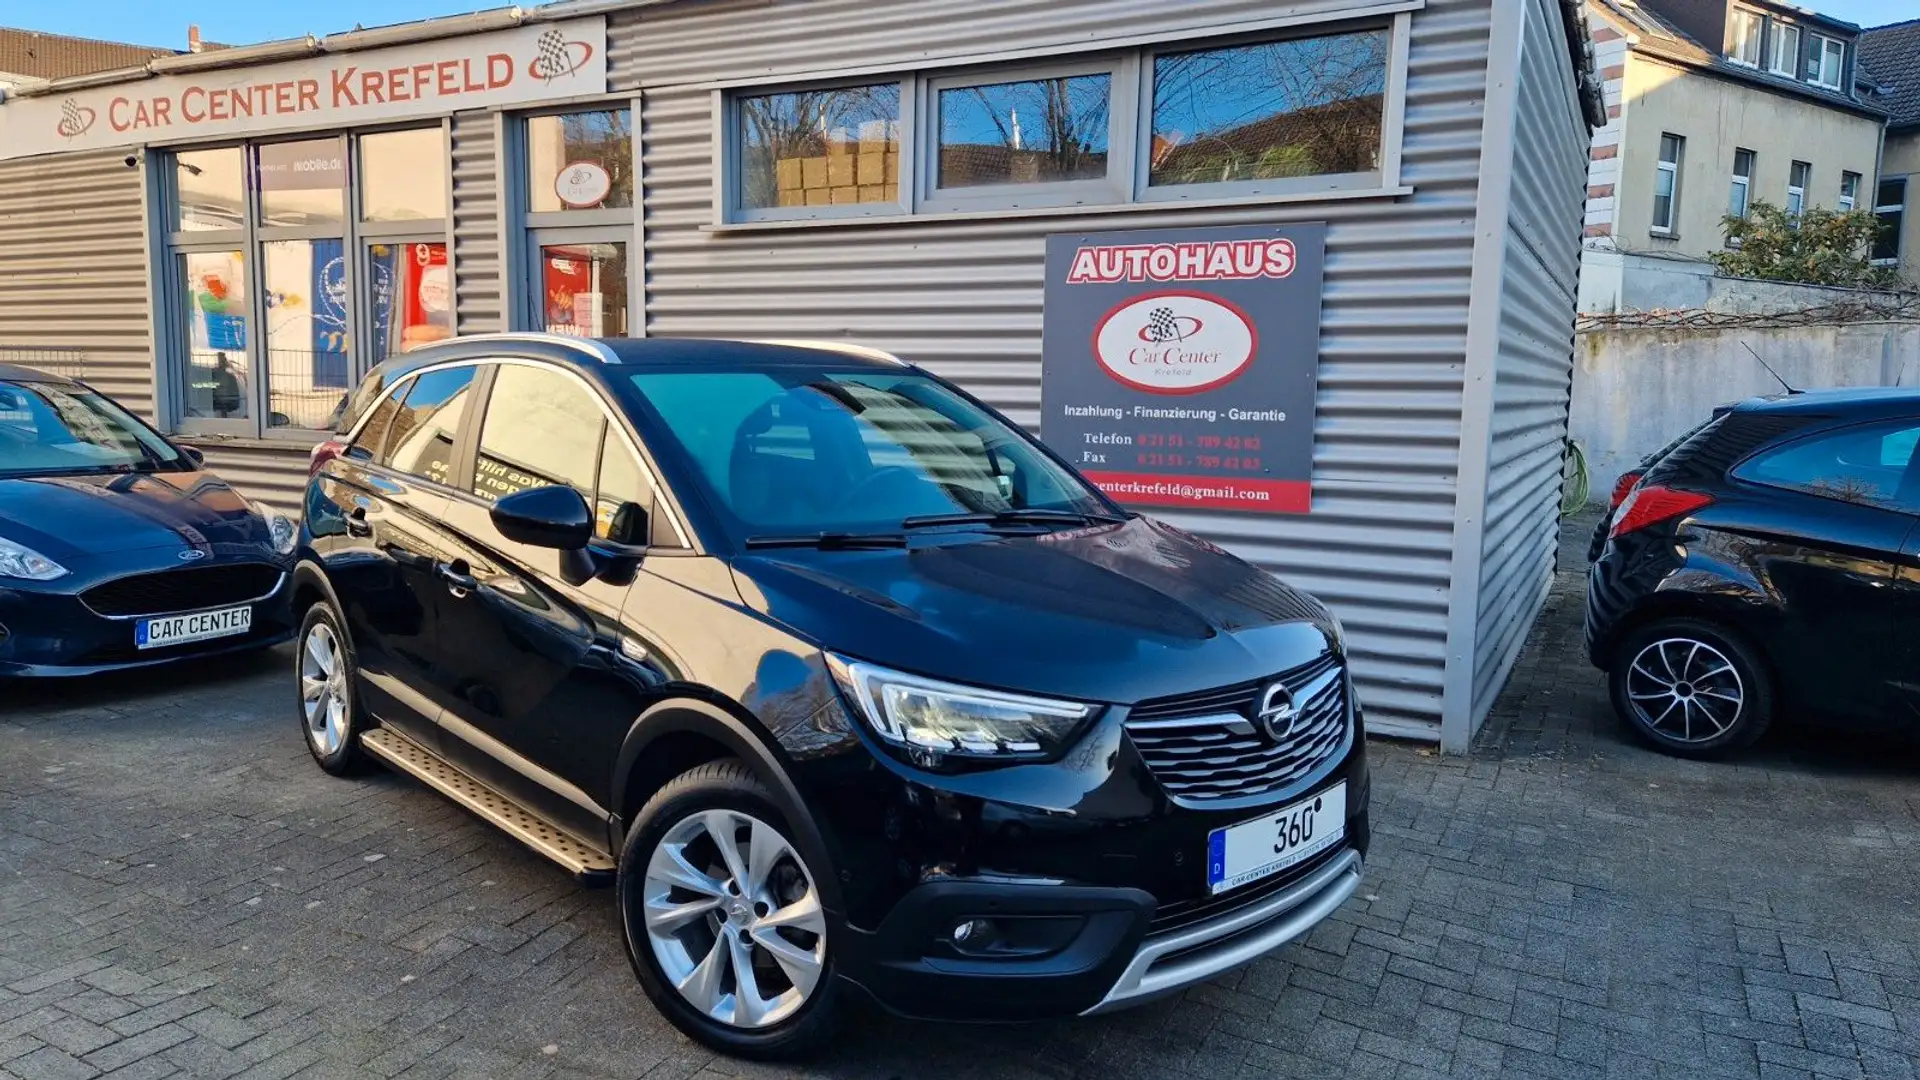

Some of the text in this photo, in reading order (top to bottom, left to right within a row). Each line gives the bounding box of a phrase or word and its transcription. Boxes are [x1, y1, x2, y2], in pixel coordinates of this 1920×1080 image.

[1066, 238, 1297, 284] AUTOHAUS
[1129, 348, 1222, 365] Car Center
[1064, 405, 1123, 419] Inzahlung
[1134, 406, 1217, 422] Finanzierung
[1228, 408, 1286, 421] Garantie
[1084, 433, 1132, 445] Telefon
[1084, 452, 1106, 463] Fax
[150, 619, 184, 639] CAR
[189, 608, 250, 633] CENTER
